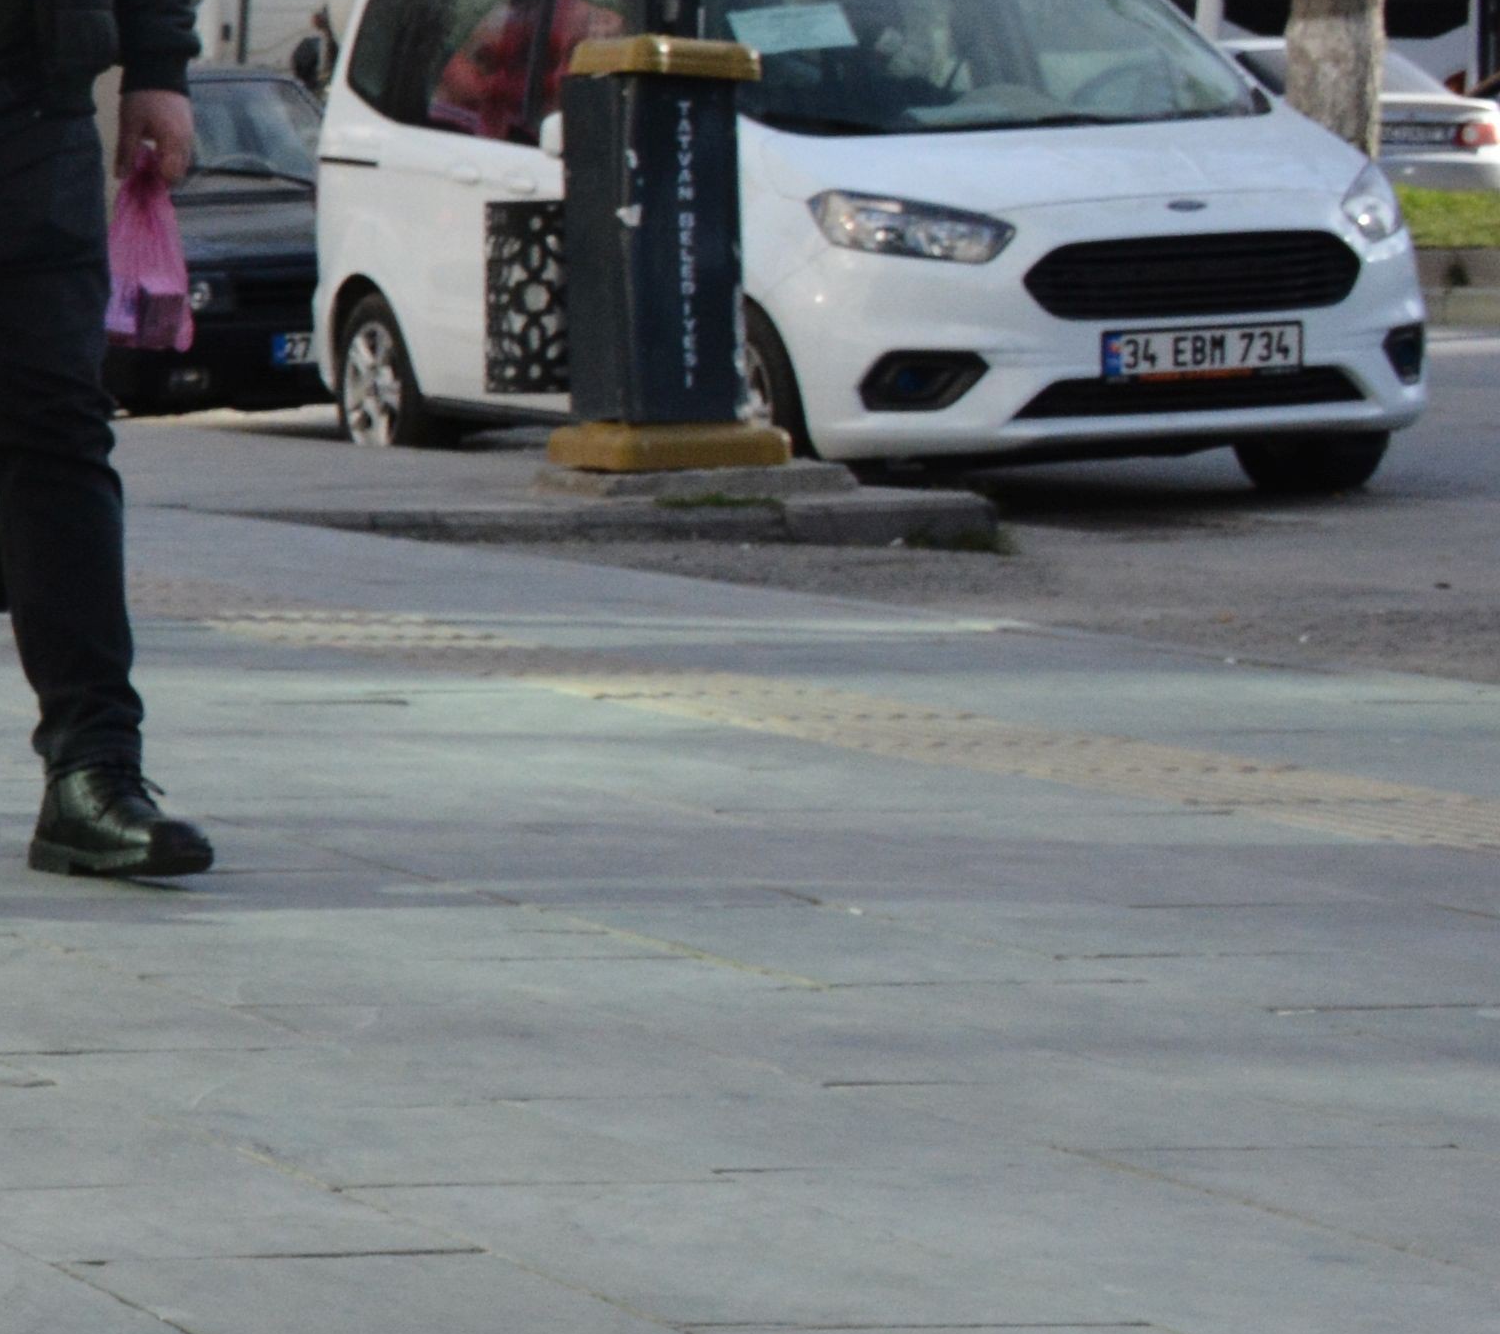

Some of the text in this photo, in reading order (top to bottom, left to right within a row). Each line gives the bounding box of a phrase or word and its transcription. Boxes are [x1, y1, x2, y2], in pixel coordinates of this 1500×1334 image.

[677, 100, 694, 200] TATVAN
[1124, 330, 1291, 369] 34 EBM 734
